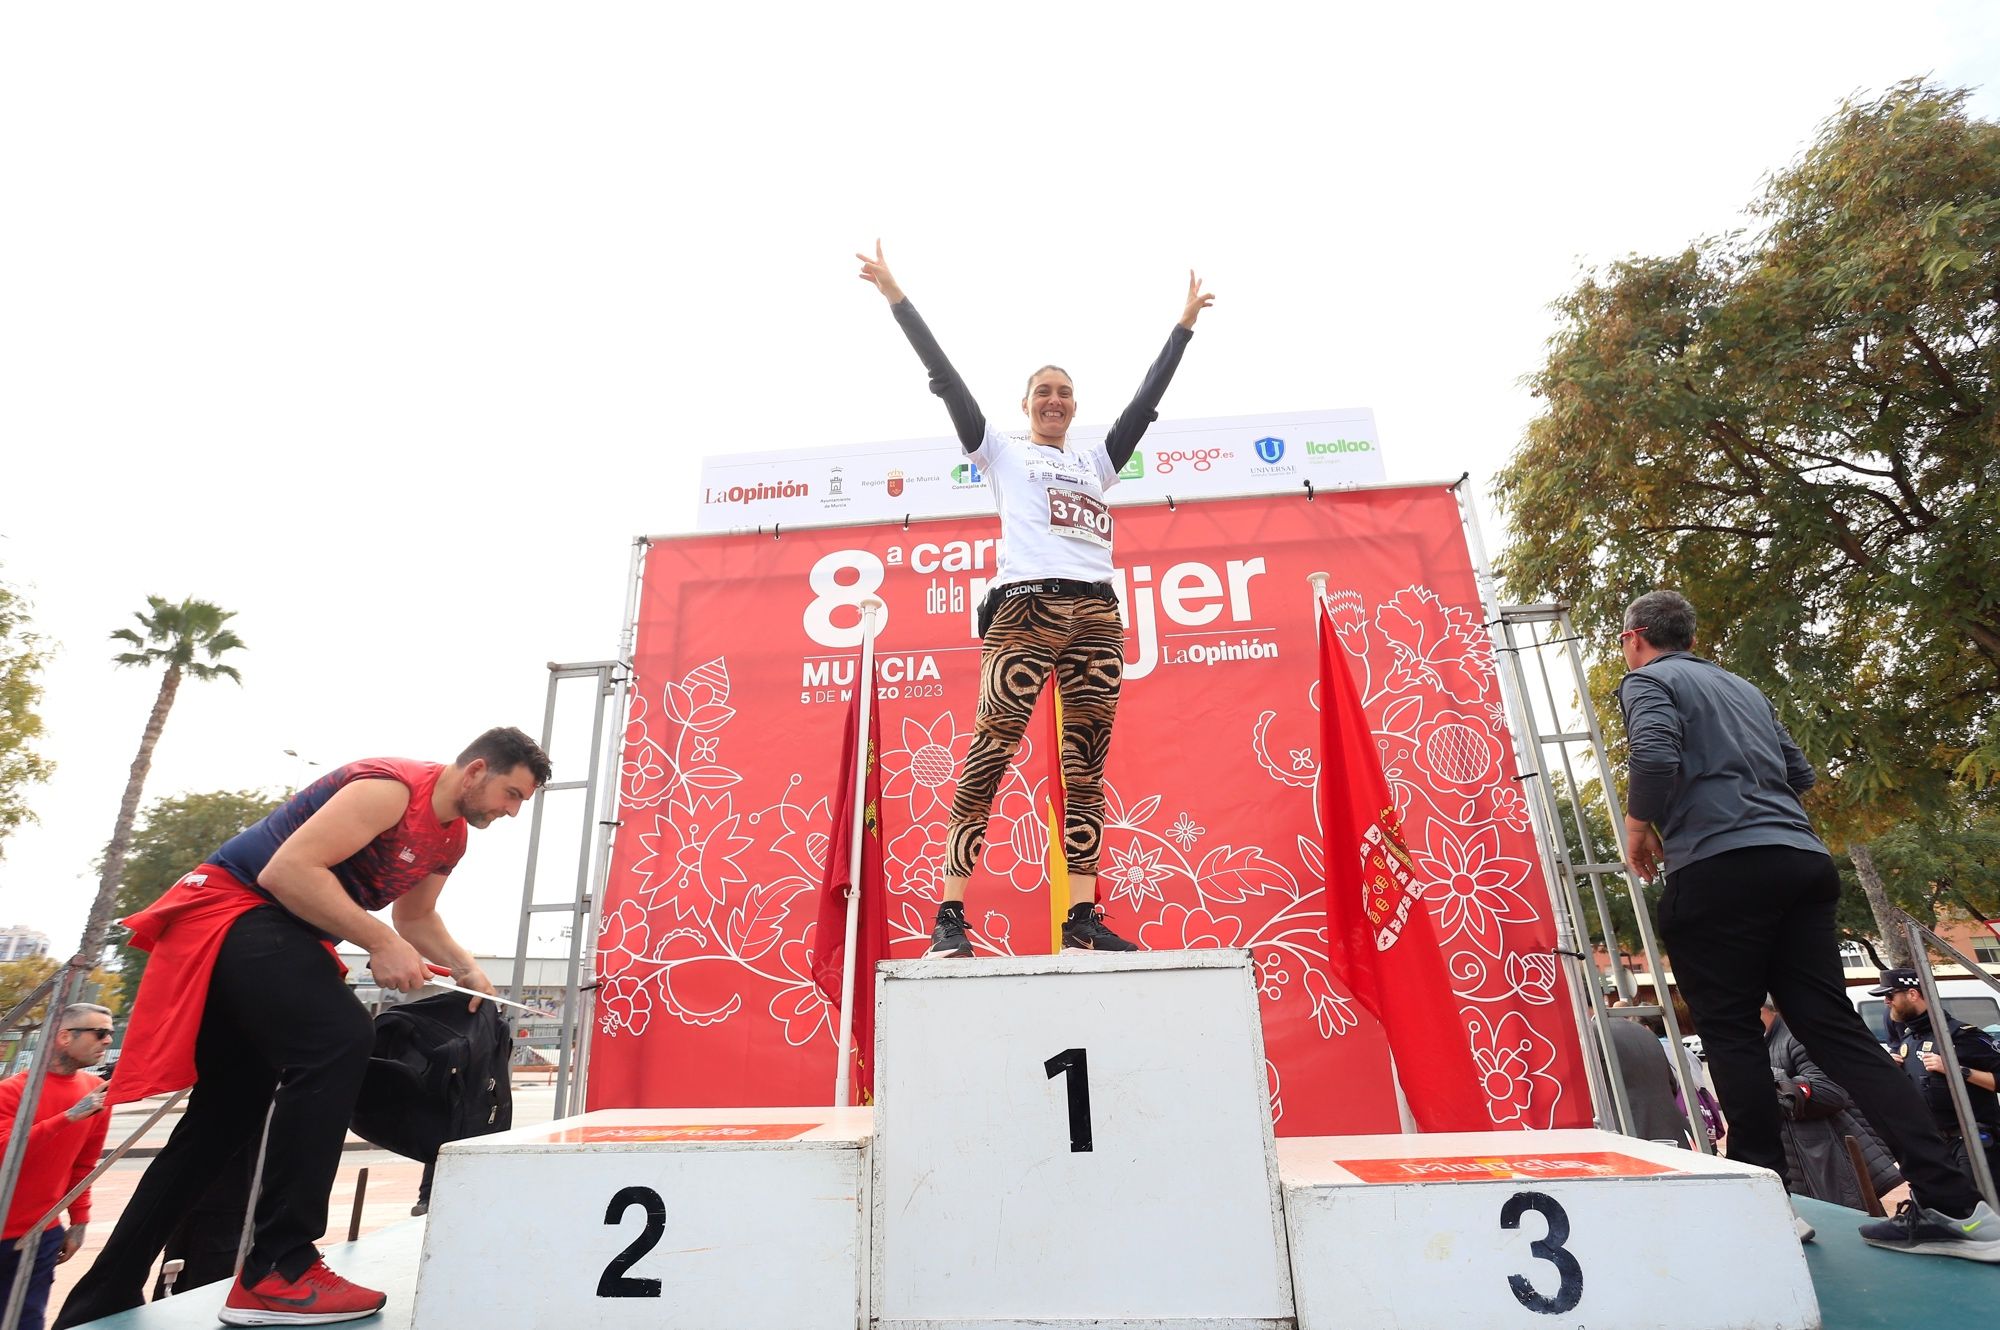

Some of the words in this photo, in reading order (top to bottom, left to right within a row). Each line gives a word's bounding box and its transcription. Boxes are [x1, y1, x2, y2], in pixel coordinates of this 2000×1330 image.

[704, 480, 809, 504] LaOpinión
[1052, 500, 1110, 533] 3780
[927, 579, 946, 614] de
[950, 576, 964, 612] la
[1005, 584, 1044, 598] OZONE
[1162, 638, 1278, 666] LaOpinión
[803, 655, 941, 687] MUCIA
[801, 692, 810, 704] 5
[815, 690, 835, 703] DE
[840, 686, 899, 702] MZO
[904, 684, 943, 699] 2023
[1044, 1048, 1093, 1153] 1
[596, 1186, 666, 1298] 2
[1500, 1191, 1584, 1315] 3
